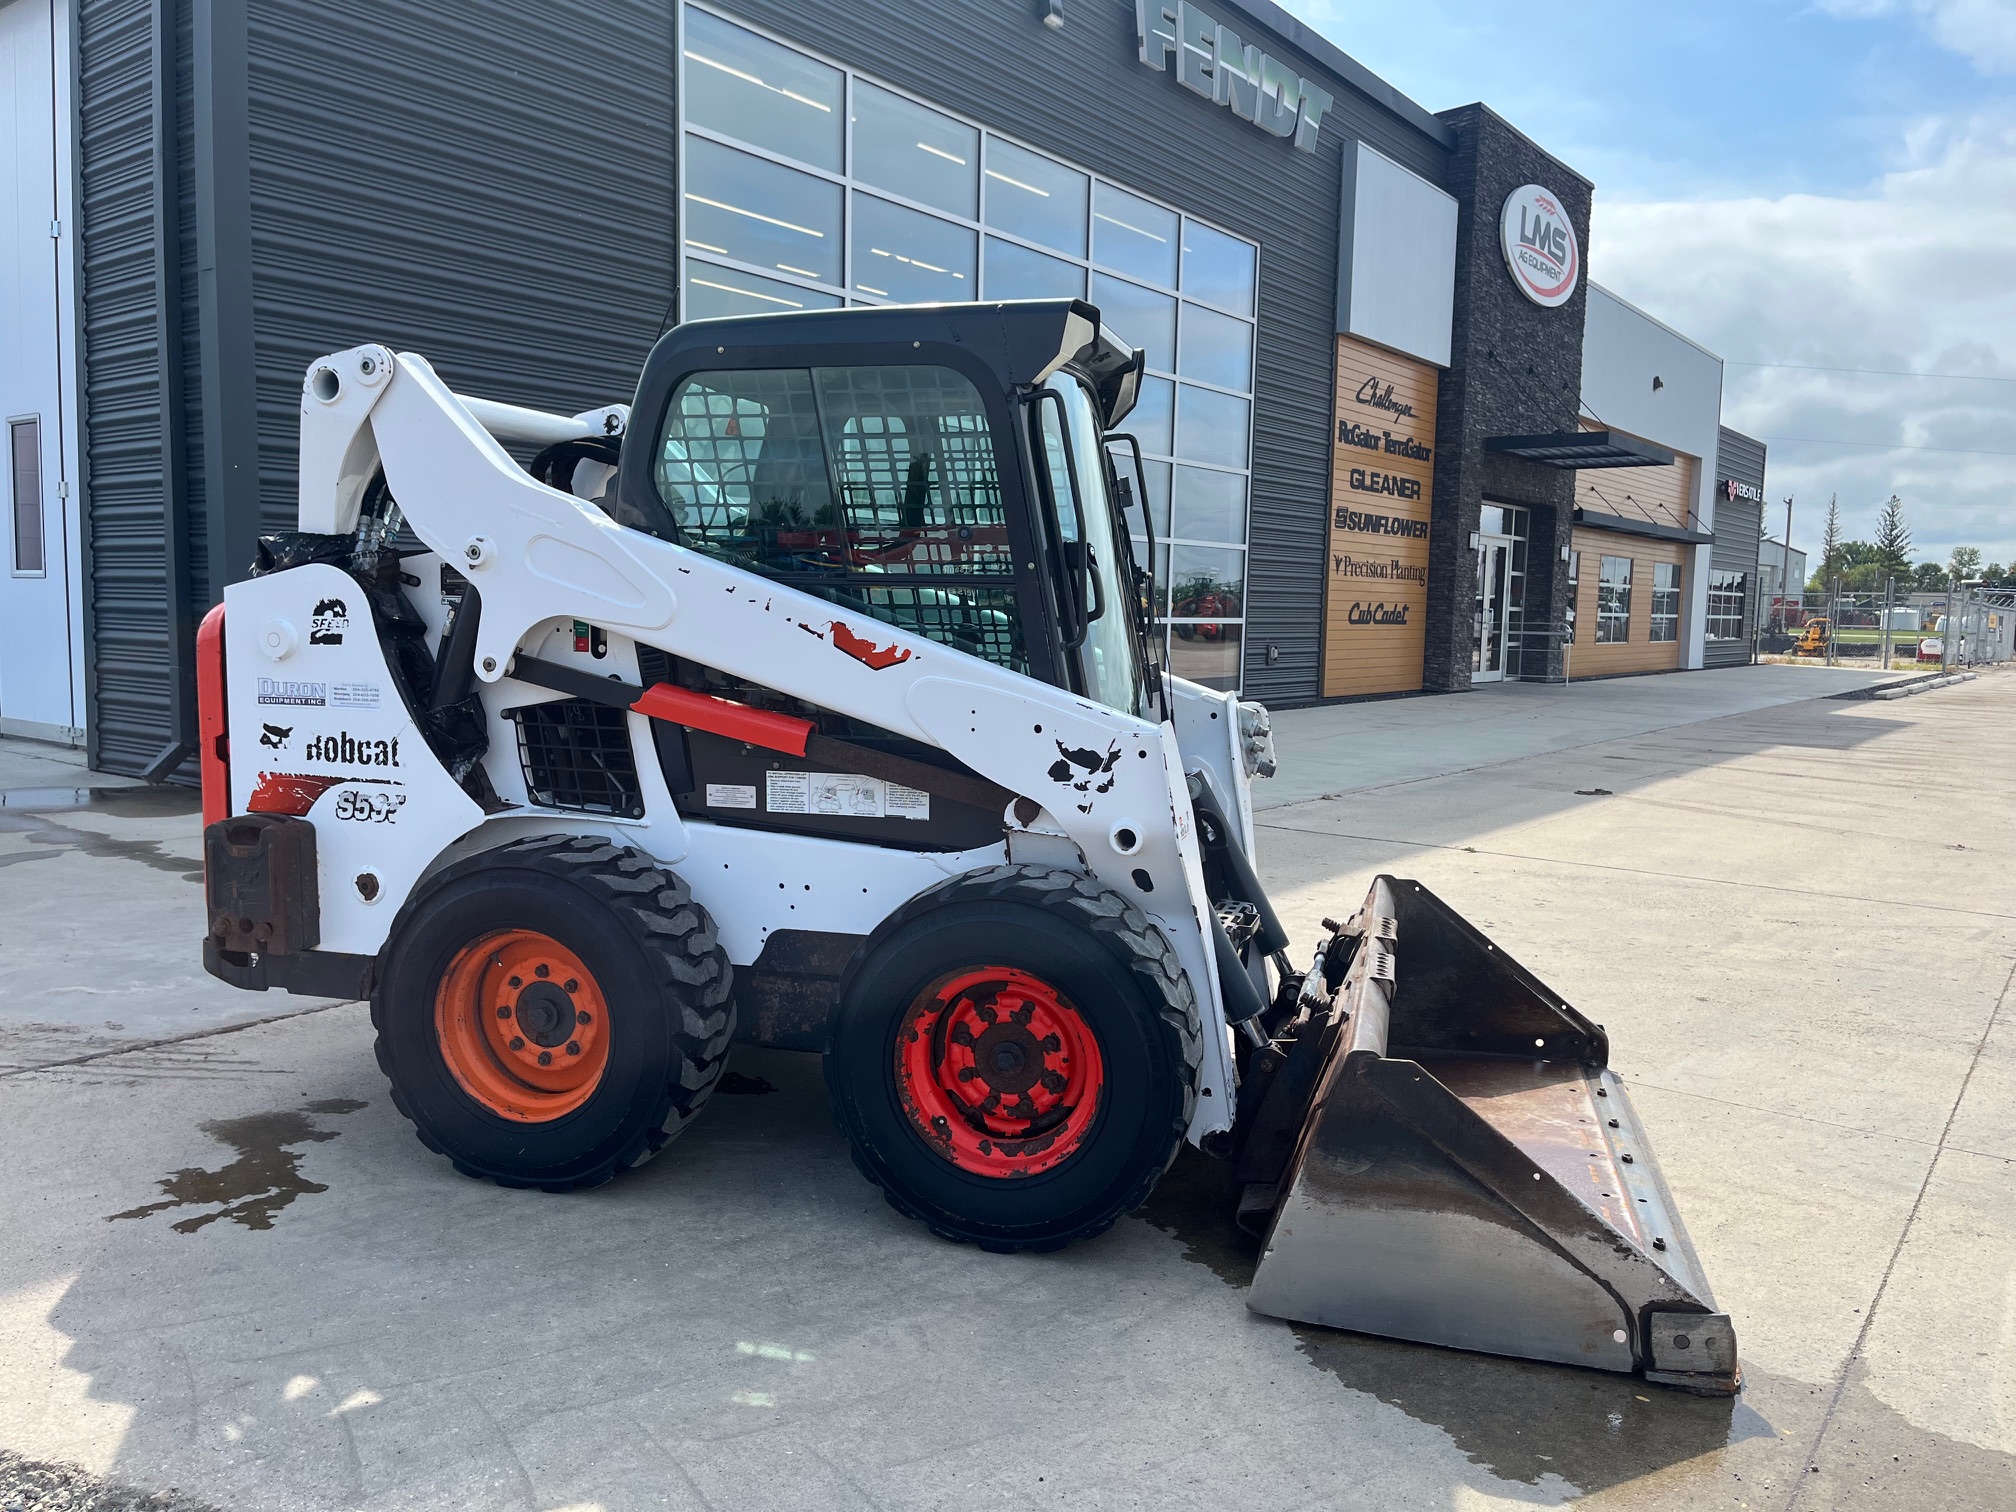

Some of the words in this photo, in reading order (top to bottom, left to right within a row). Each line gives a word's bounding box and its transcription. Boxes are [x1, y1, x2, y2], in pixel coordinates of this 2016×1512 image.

[1136, 0, 1334, 154] FENDT
[1520, 205, 1568, 267] LMS
[1518, 249, 1528, 262] AG
[1528, 254, 1562, 282] EQUIPMENT
[1356, 376, 1420, 424] Challenger
[1338, 420, 1381, 451] RoGator
[1383, 431, 1431, 462] TerraGator
[1350, 468, 1421, 500] GLEANER
[1347, 511, 1429, 539] SUNFLOWER
[1344, 555, 1388, 578] Precision
[1390, 559, 1427, 587] Planting
[1348, 602, 1372, 625] Cub
[1373, 602, 1410, 625] Cadet
[257, 677, 326, 698] DURON
[259, 697, 306, 705] EQUIPMENT
[307, 698, 325, 706] INC.
